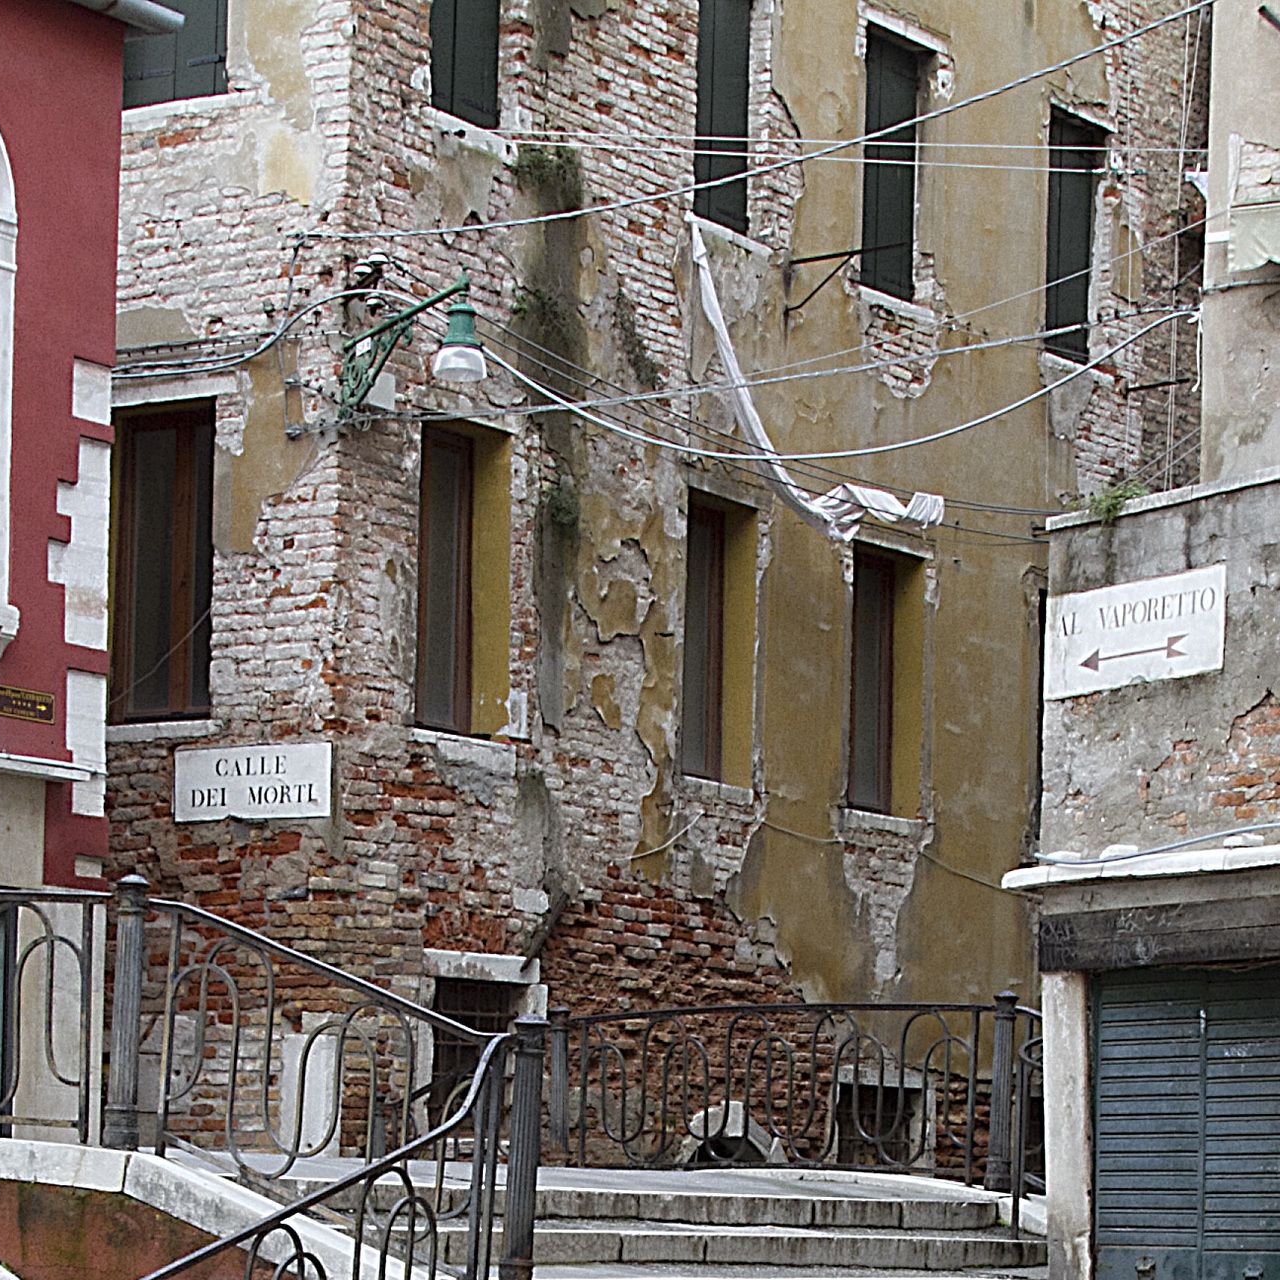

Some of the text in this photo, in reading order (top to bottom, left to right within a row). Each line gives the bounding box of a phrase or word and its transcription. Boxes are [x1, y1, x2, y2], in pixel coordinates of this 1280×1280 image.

[1056, 586, 1217, 639] AL VAPORETTO
[215, 755, 287, 777] CALLE
[191, 783, 314, 808] DEI MORTI
